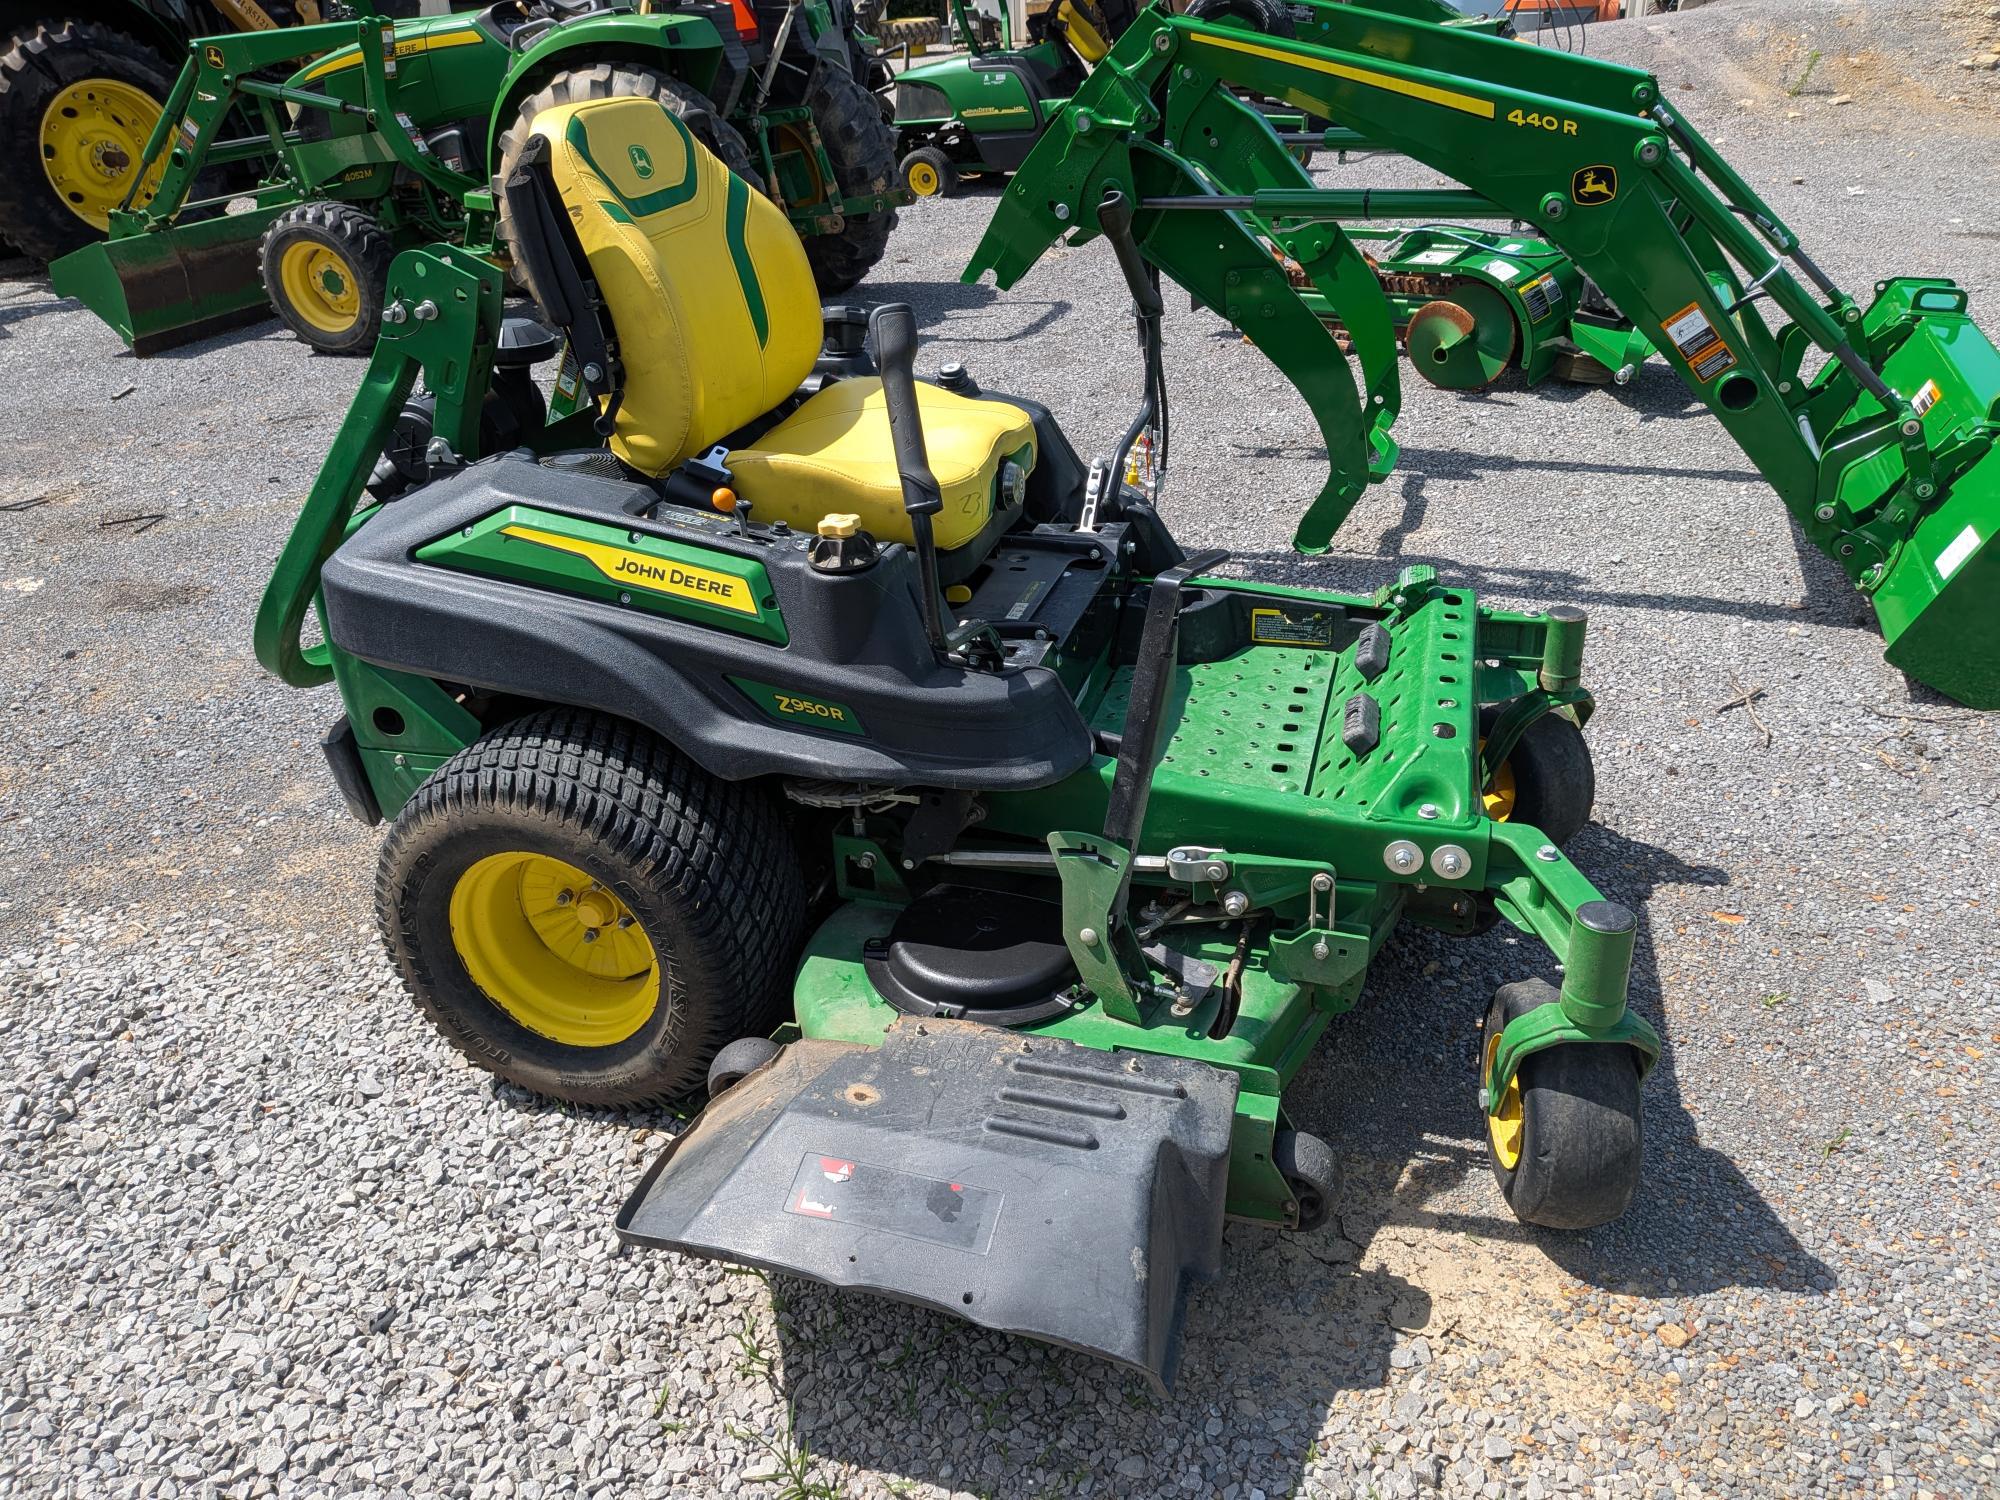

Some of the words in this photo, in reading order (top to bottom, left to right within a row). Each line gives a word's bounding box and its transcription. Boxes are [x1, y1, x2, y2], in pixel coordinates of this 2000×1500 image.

[615, 557, 666, 582] JOHN
[669, 569, 734, 598] DEERE
[774, 694, 845, 721] Z950R
